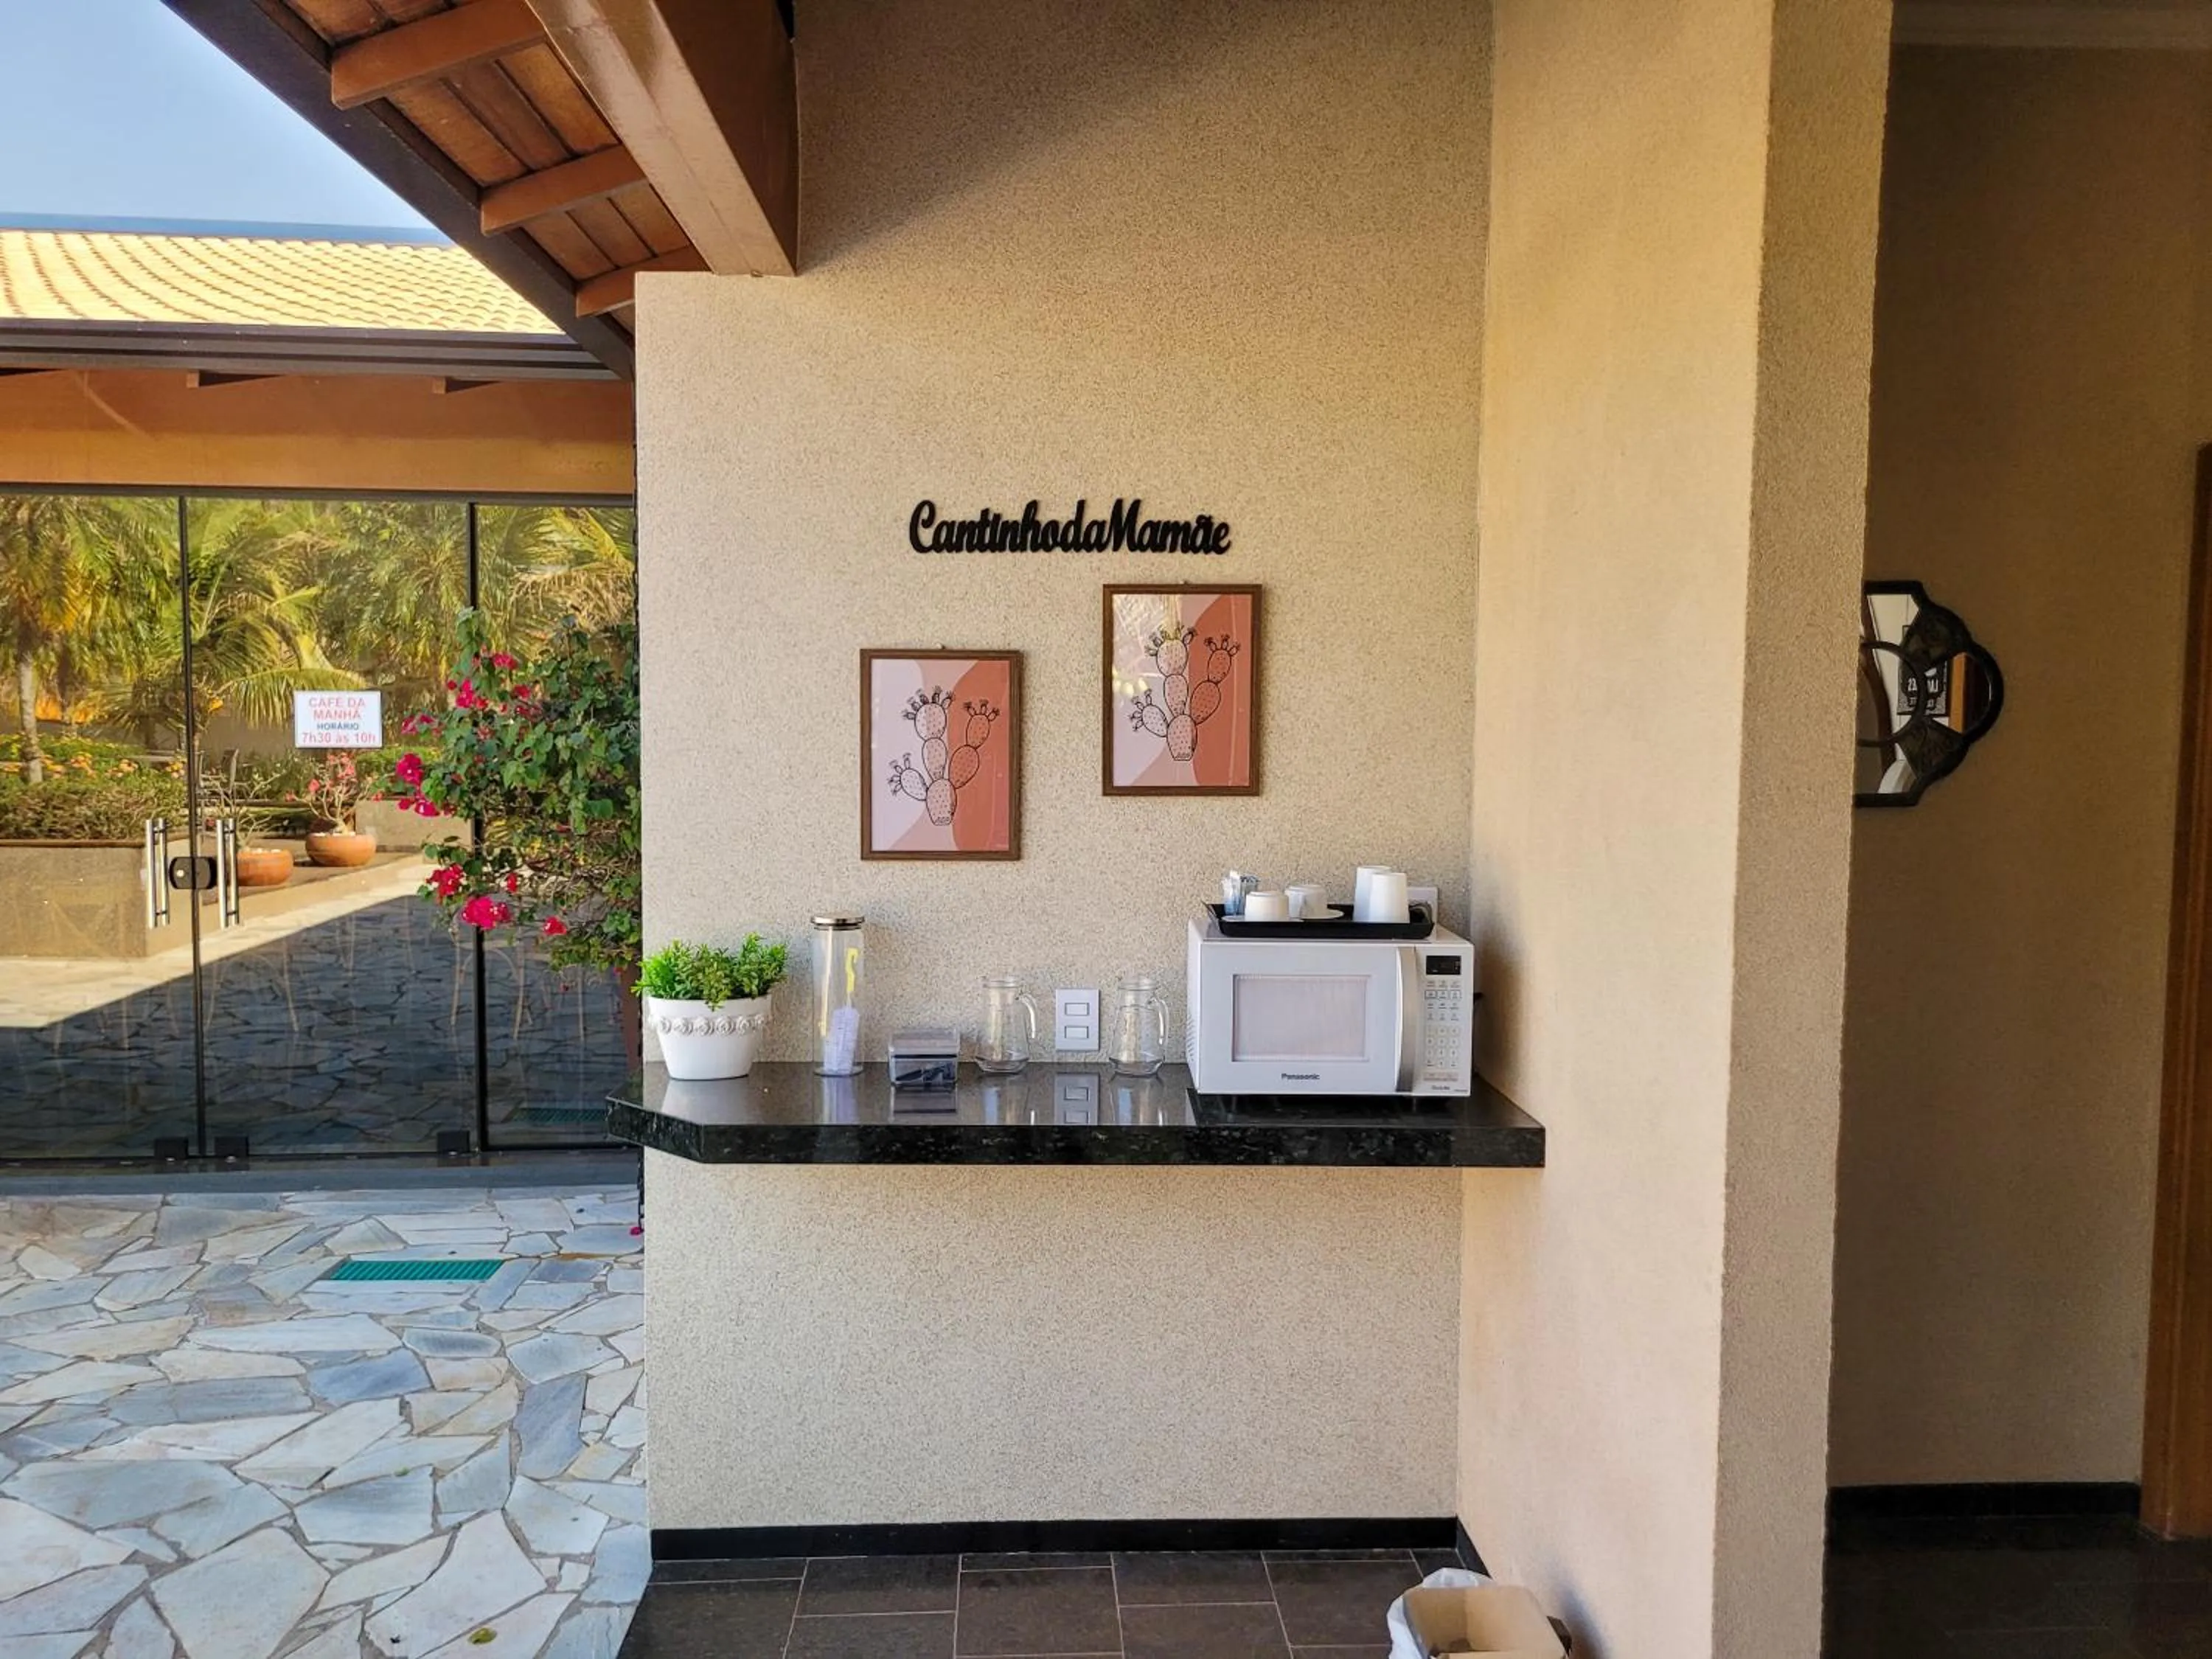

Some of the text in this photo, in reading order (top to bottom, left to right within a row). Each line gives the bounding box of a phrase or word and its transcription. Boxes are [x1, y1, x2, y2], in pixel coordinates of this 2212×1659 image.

[347, 697, 365, 708] DA
[302, 732, 331, 744] 7h30
[355, 732, 376, 744] 10h
[1281, 1073, 1321, 1081] Panasonic
